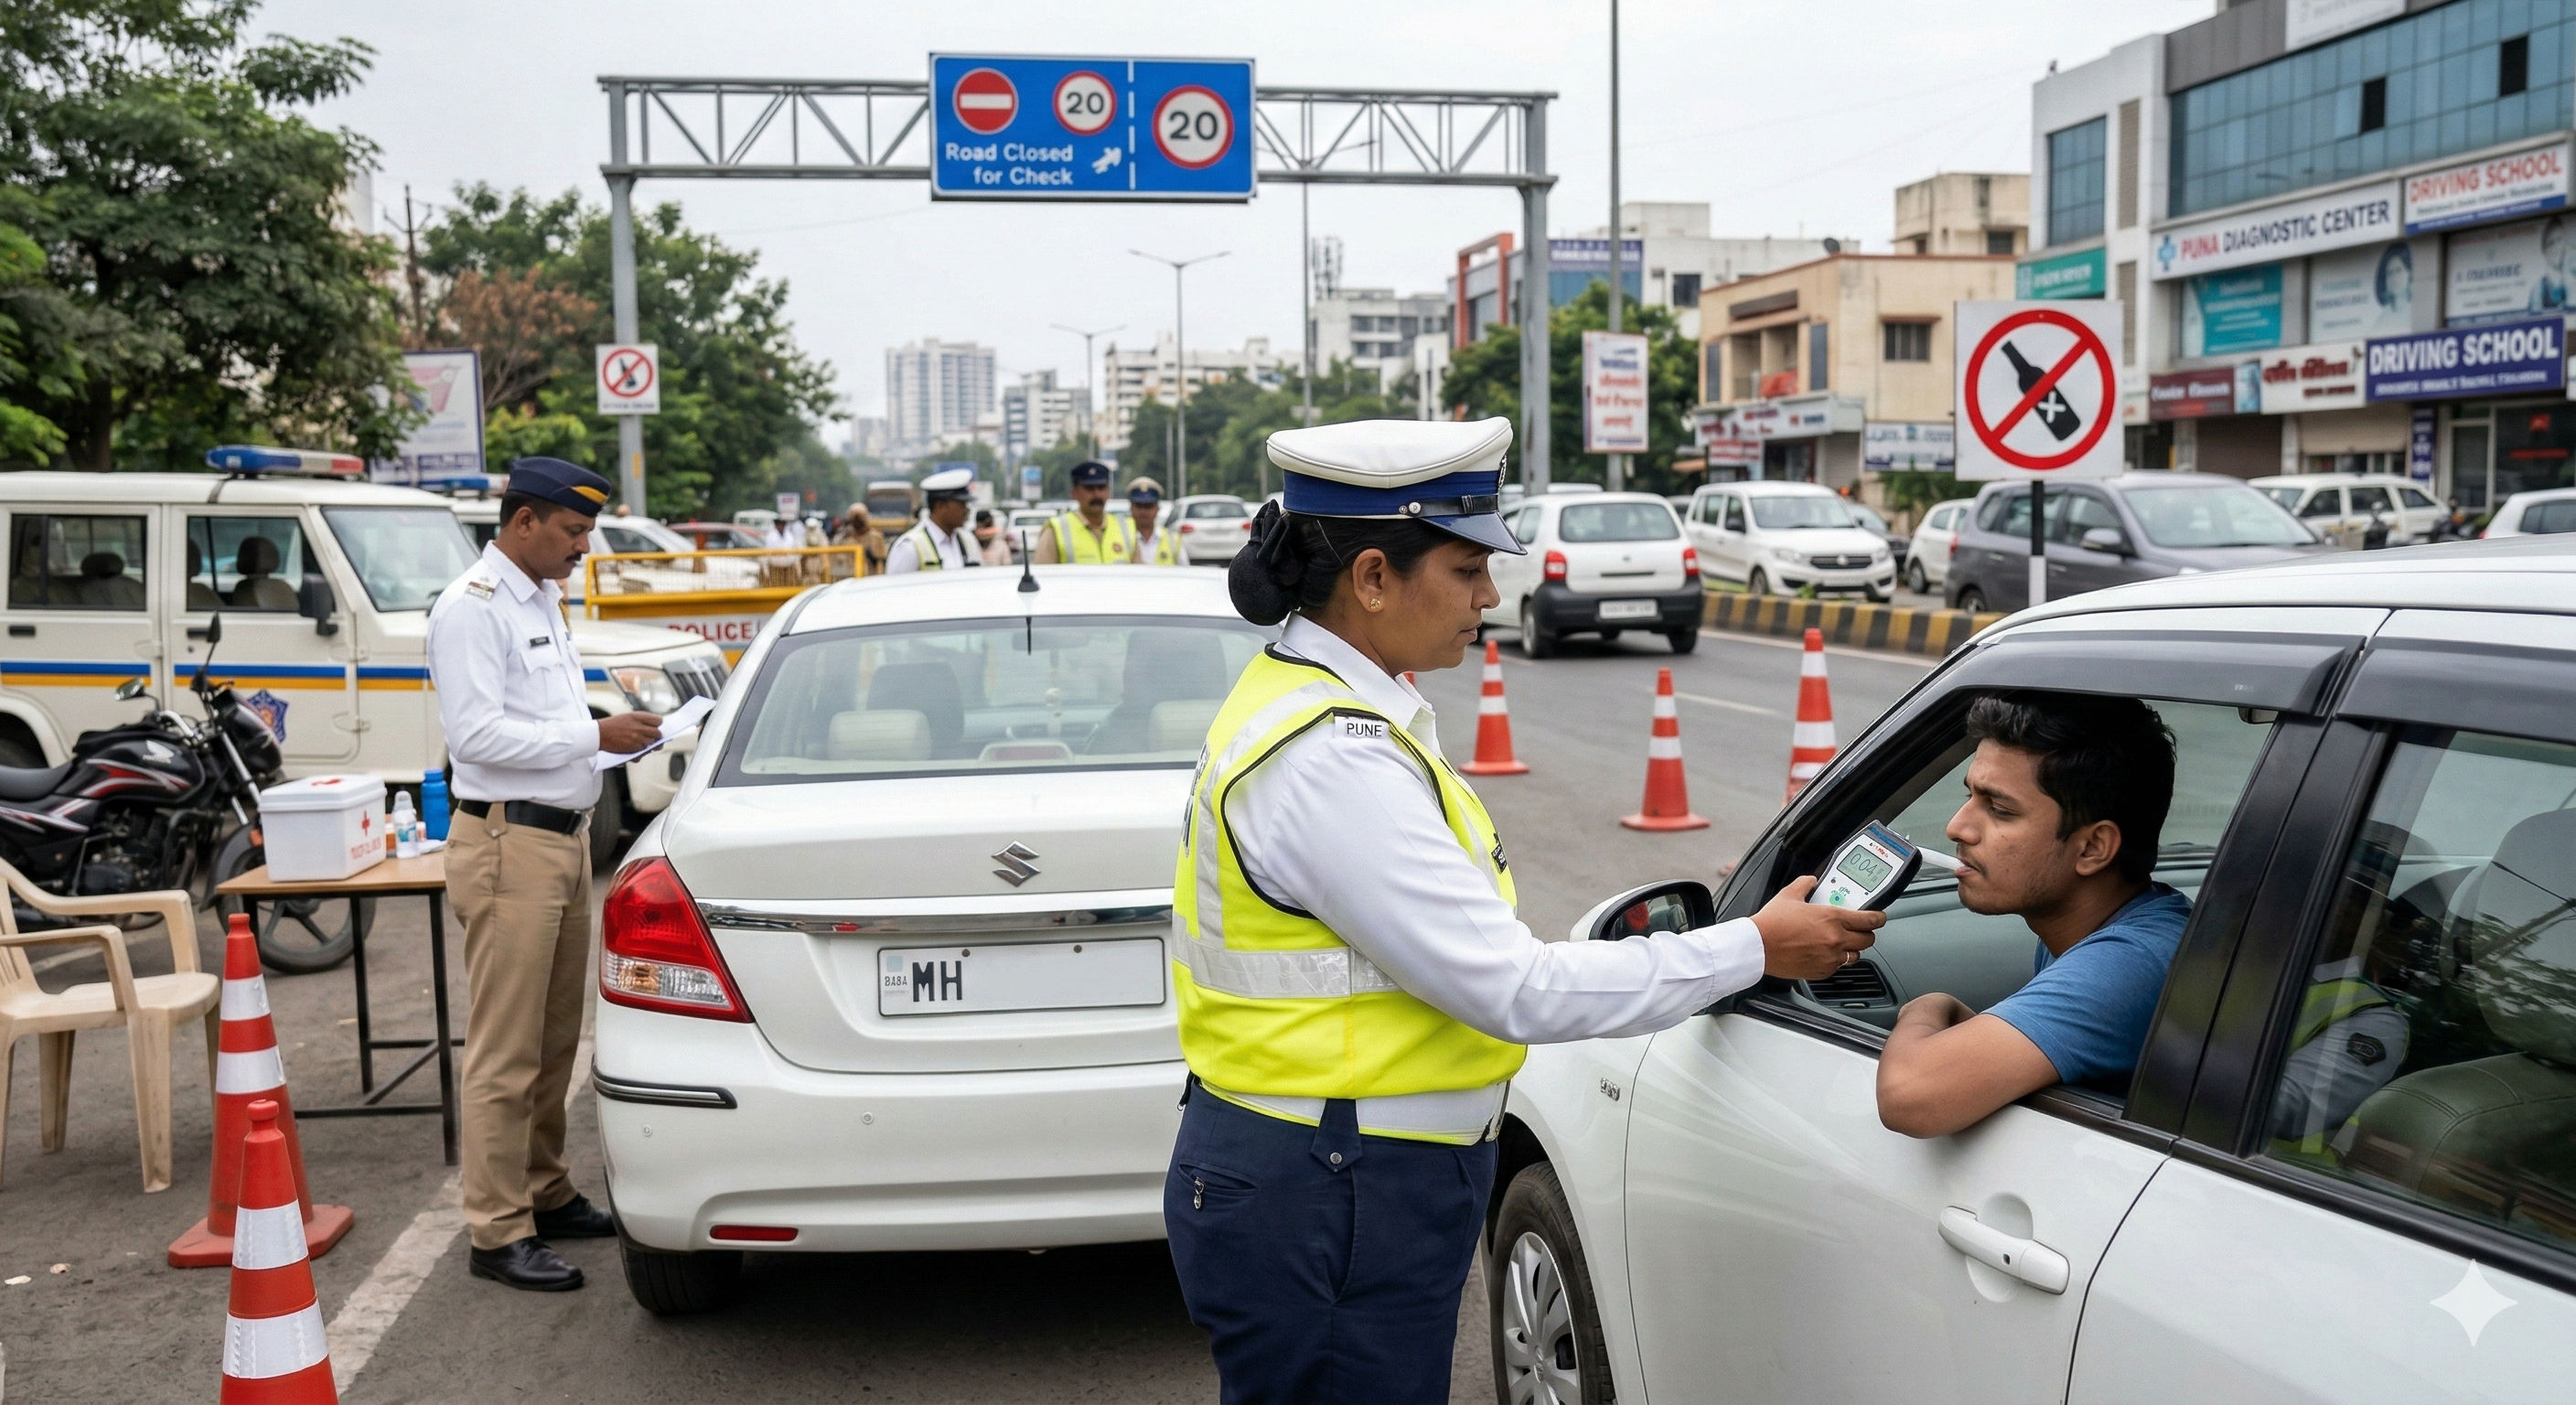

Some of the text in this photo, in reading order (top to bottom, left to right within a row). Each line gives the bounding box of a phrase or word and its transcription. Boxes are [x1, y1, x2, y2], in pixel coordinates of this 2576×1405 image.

[1067, 92, 1104, 114] 20
[1169, 111, 1218, 141] 20
[946, 143, 1074, 162] Road Closed
[973, 166, 1074, 186] for Check
[2410, 167, 2480, 204] DRIVING
[2485, 150, 2561, 188] SCHOOL
[2181, 233, 2218, 261] PUNA
[2223, 214, 2317, 253] DIAGNOSTIC
[2322, 199, 2390, 234] CENTER
[2369, 336, 2458, 375] DRIVING
[2463, 327, 2560, 366] SCHOOL
[1347, 724, 1381, 736] PUNE
[913, 960, 962, 1002] MH
